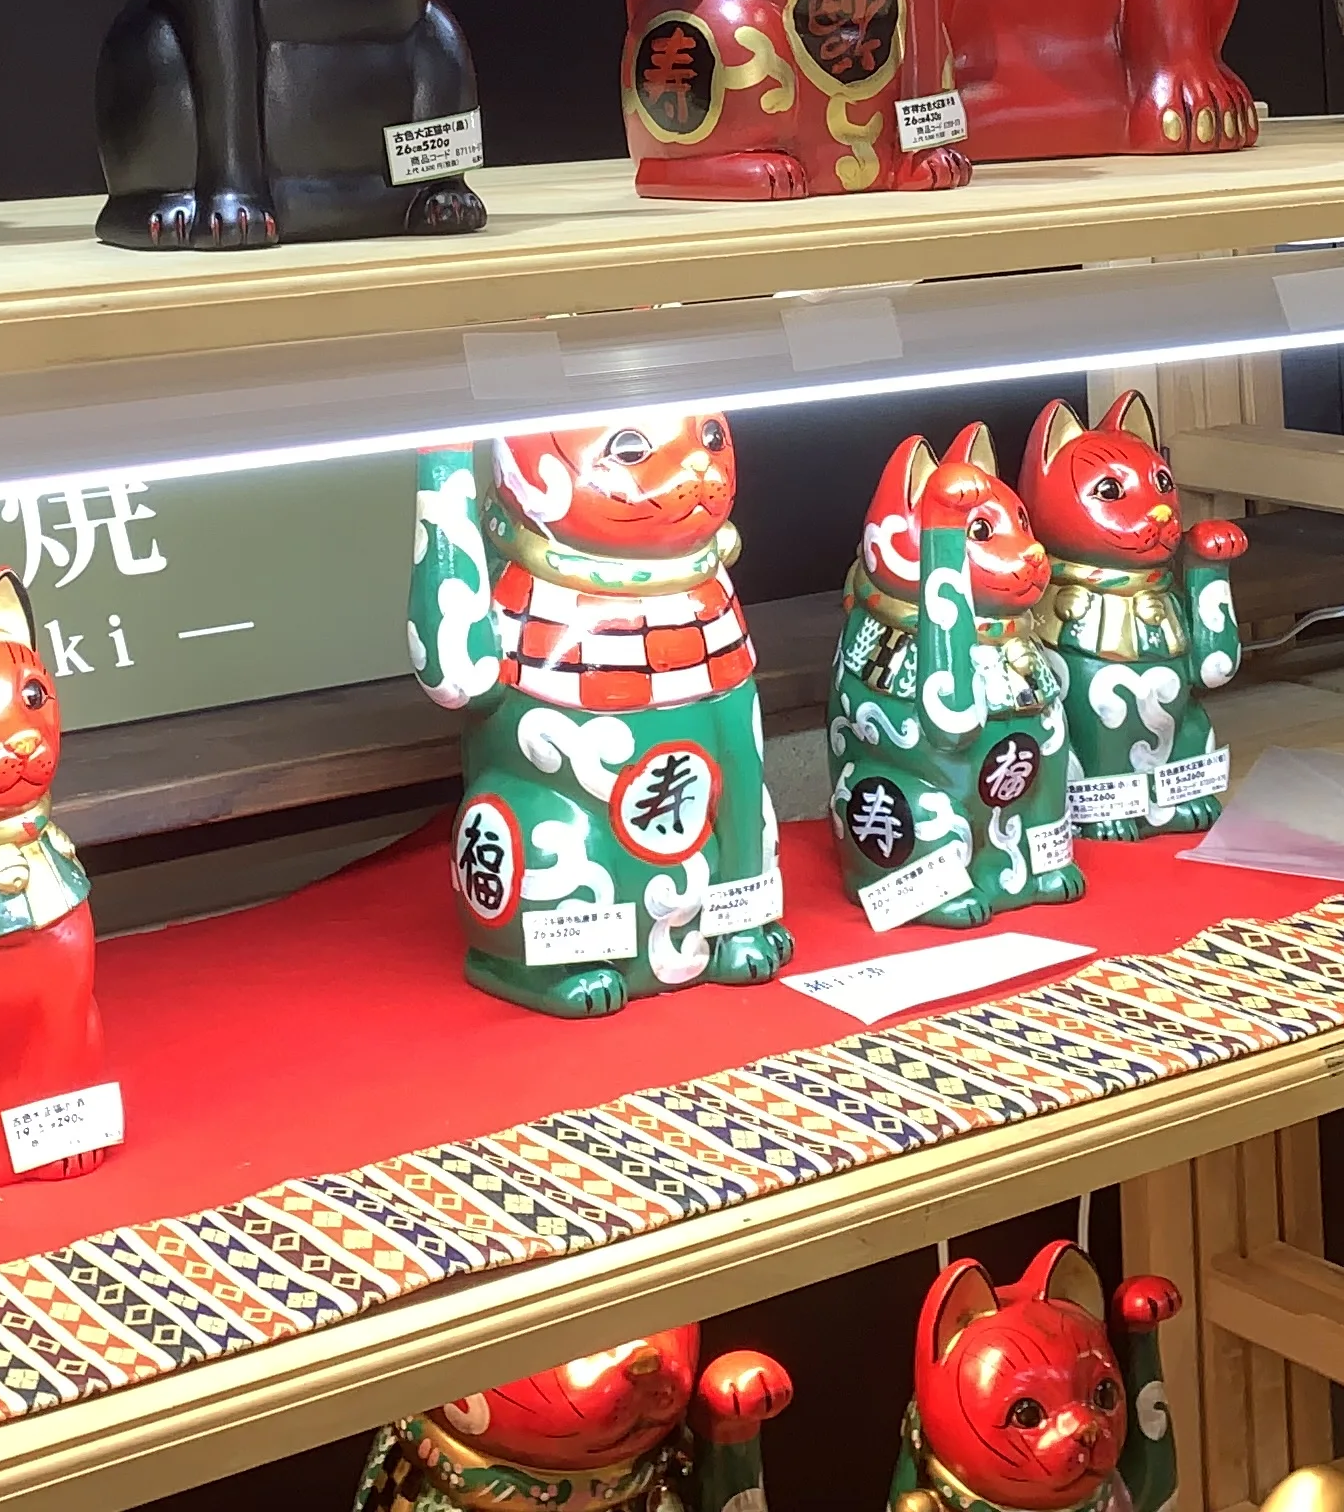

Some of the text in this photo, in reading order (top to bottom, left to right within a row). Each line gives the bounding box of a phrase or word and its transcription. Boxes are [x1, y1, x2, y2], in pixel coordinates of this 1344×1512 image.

[410, 149, 451, 166] 商品コード
[630, 754, 699, 835] 寿
[853, 785, 904, 859] 寿
[460, 813, 504, 910] 福
